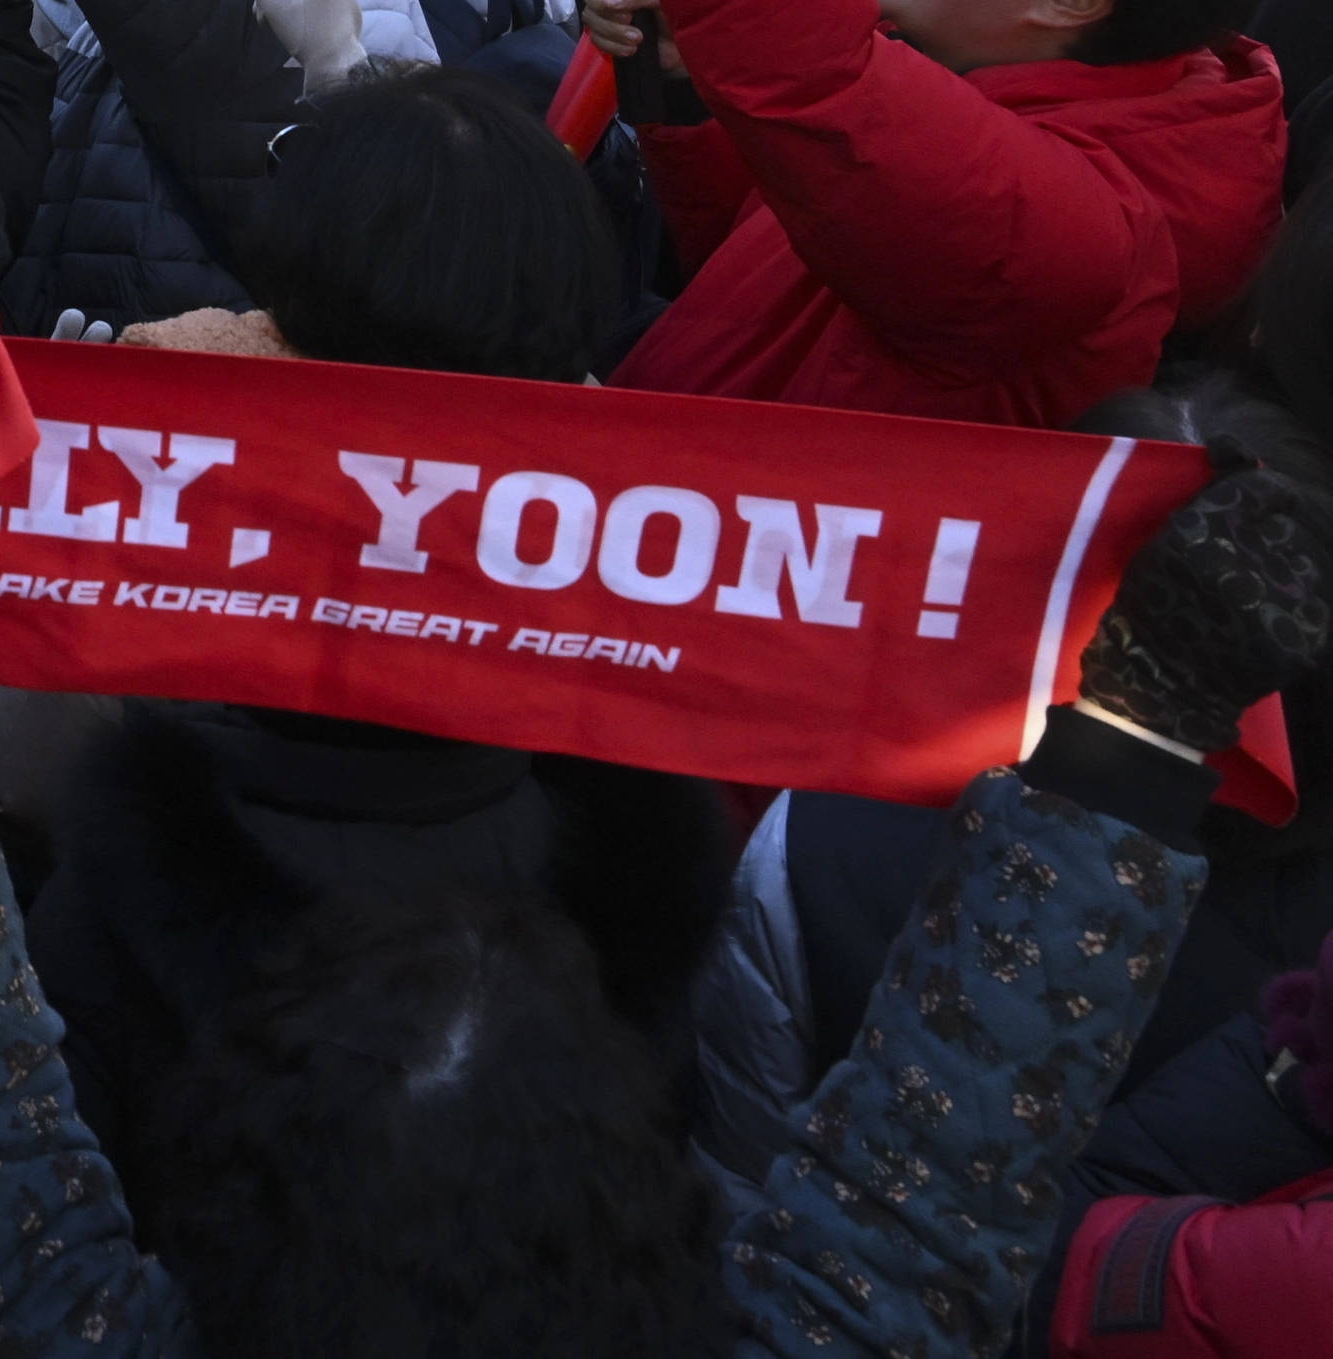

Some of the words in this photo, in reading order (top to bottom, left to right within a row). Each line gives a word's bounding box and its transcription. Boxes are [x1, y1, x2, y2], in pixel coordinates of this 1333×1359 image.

[113, 581, 300, 621] KOREA
[310, 599, 497, 648] GREAT
[507, 626, 681, 675] AGAIN
